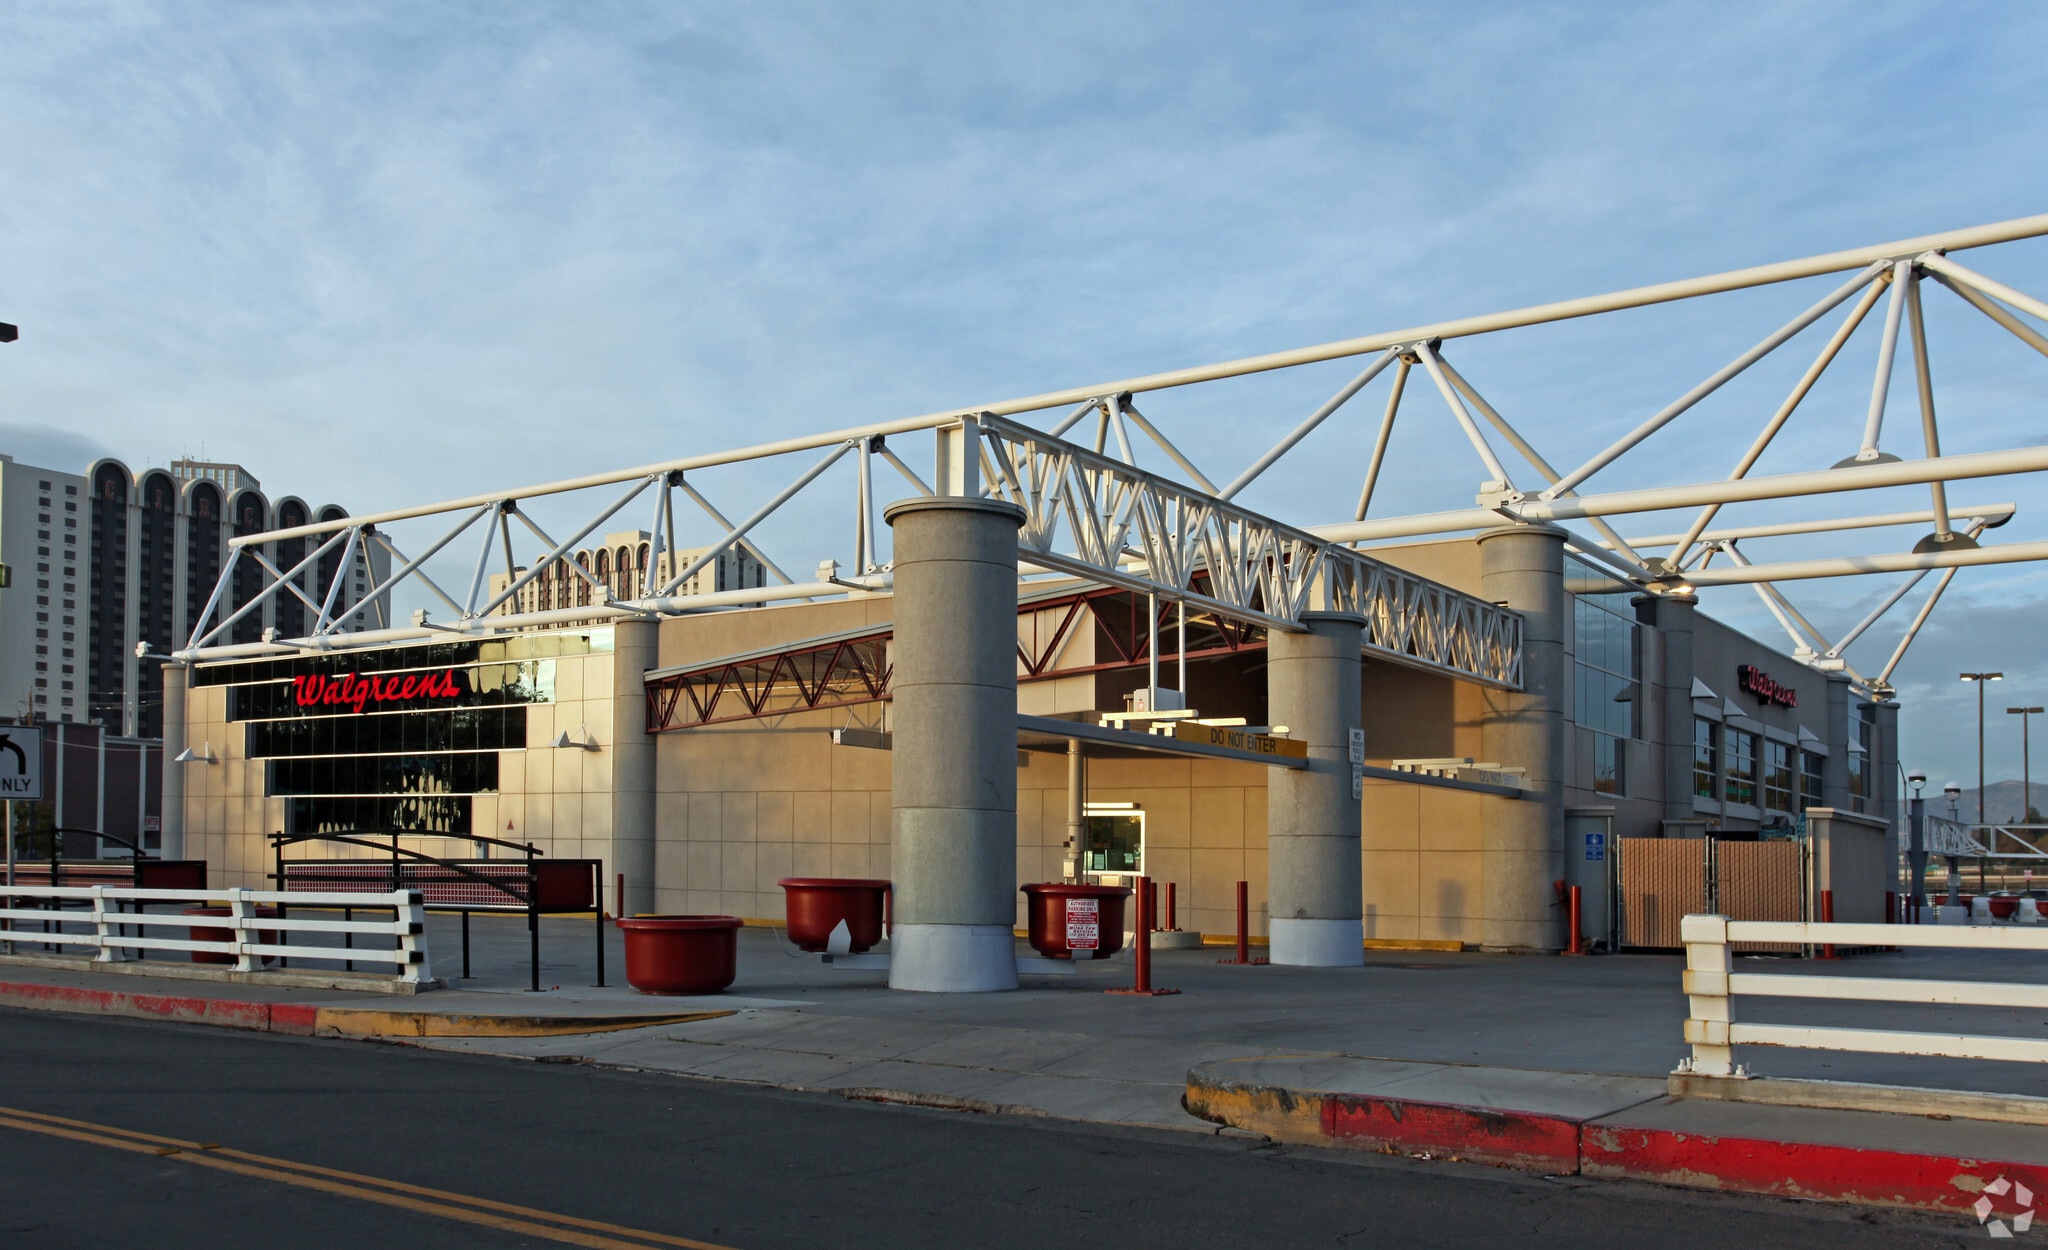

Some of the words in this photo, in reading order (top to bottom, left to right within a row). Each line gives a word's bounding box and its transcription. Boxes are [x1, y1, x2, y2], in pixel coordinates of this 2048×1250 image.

[292, 668, 461, 714] Walgreens
[1747, 664, 1799, 707] Walgreens
[1210, 728, 1225, 745] DO
[1228, 731, 1244, 748] NOT
[1247, 735, 1277, 753] ENTER
[0, 778, 31, 792] NLY
